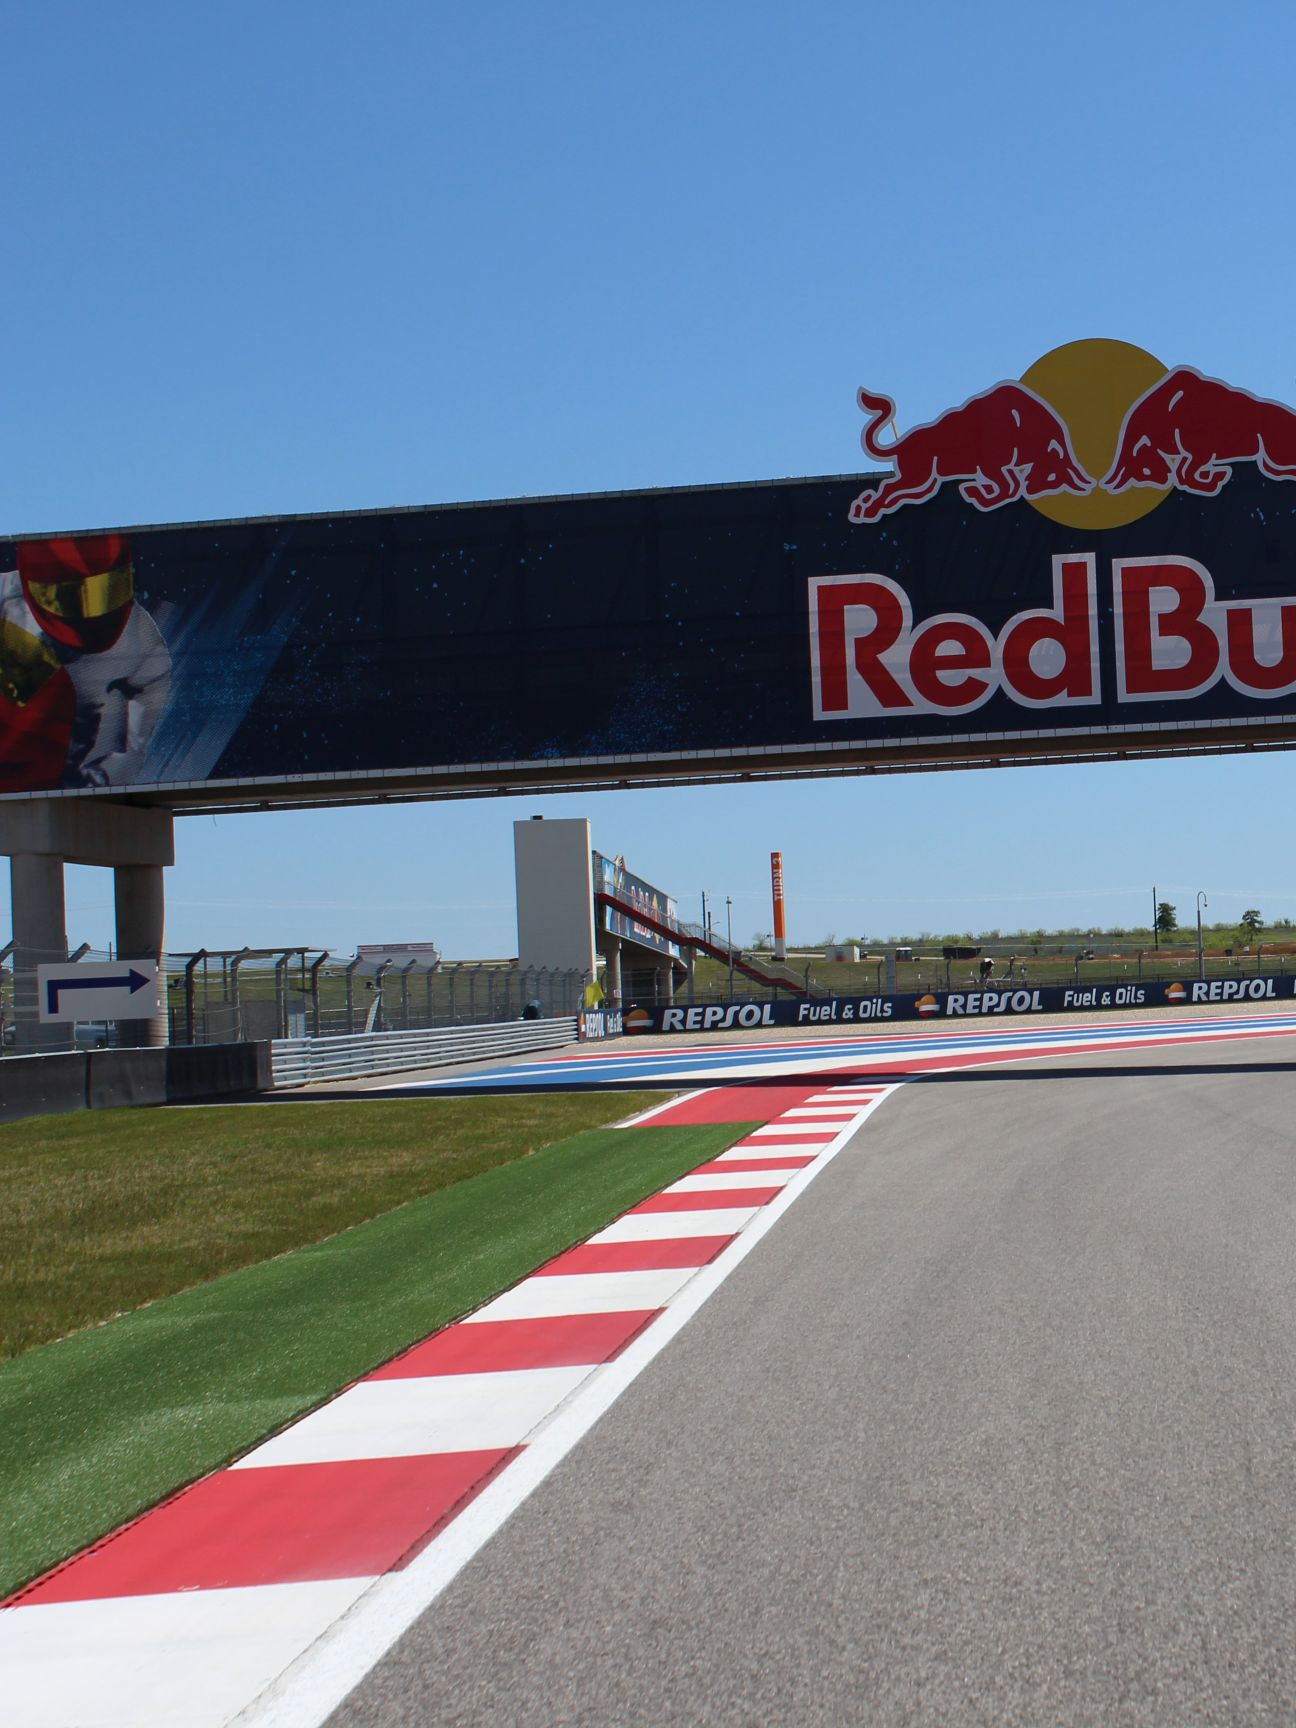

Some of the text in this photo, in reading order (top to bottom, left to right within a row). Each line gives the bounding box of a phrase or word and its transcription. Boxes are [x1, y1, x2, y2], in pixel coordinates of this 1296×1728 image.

[811, 555, 1098, 717] Red
[946, 985, 1145, 1015] REPSOL Fuel & Oils
[1192, 979, 1276, 1002] REPSOL
[662, 998, 892, 1031] REPSOL Fuel & Oils
